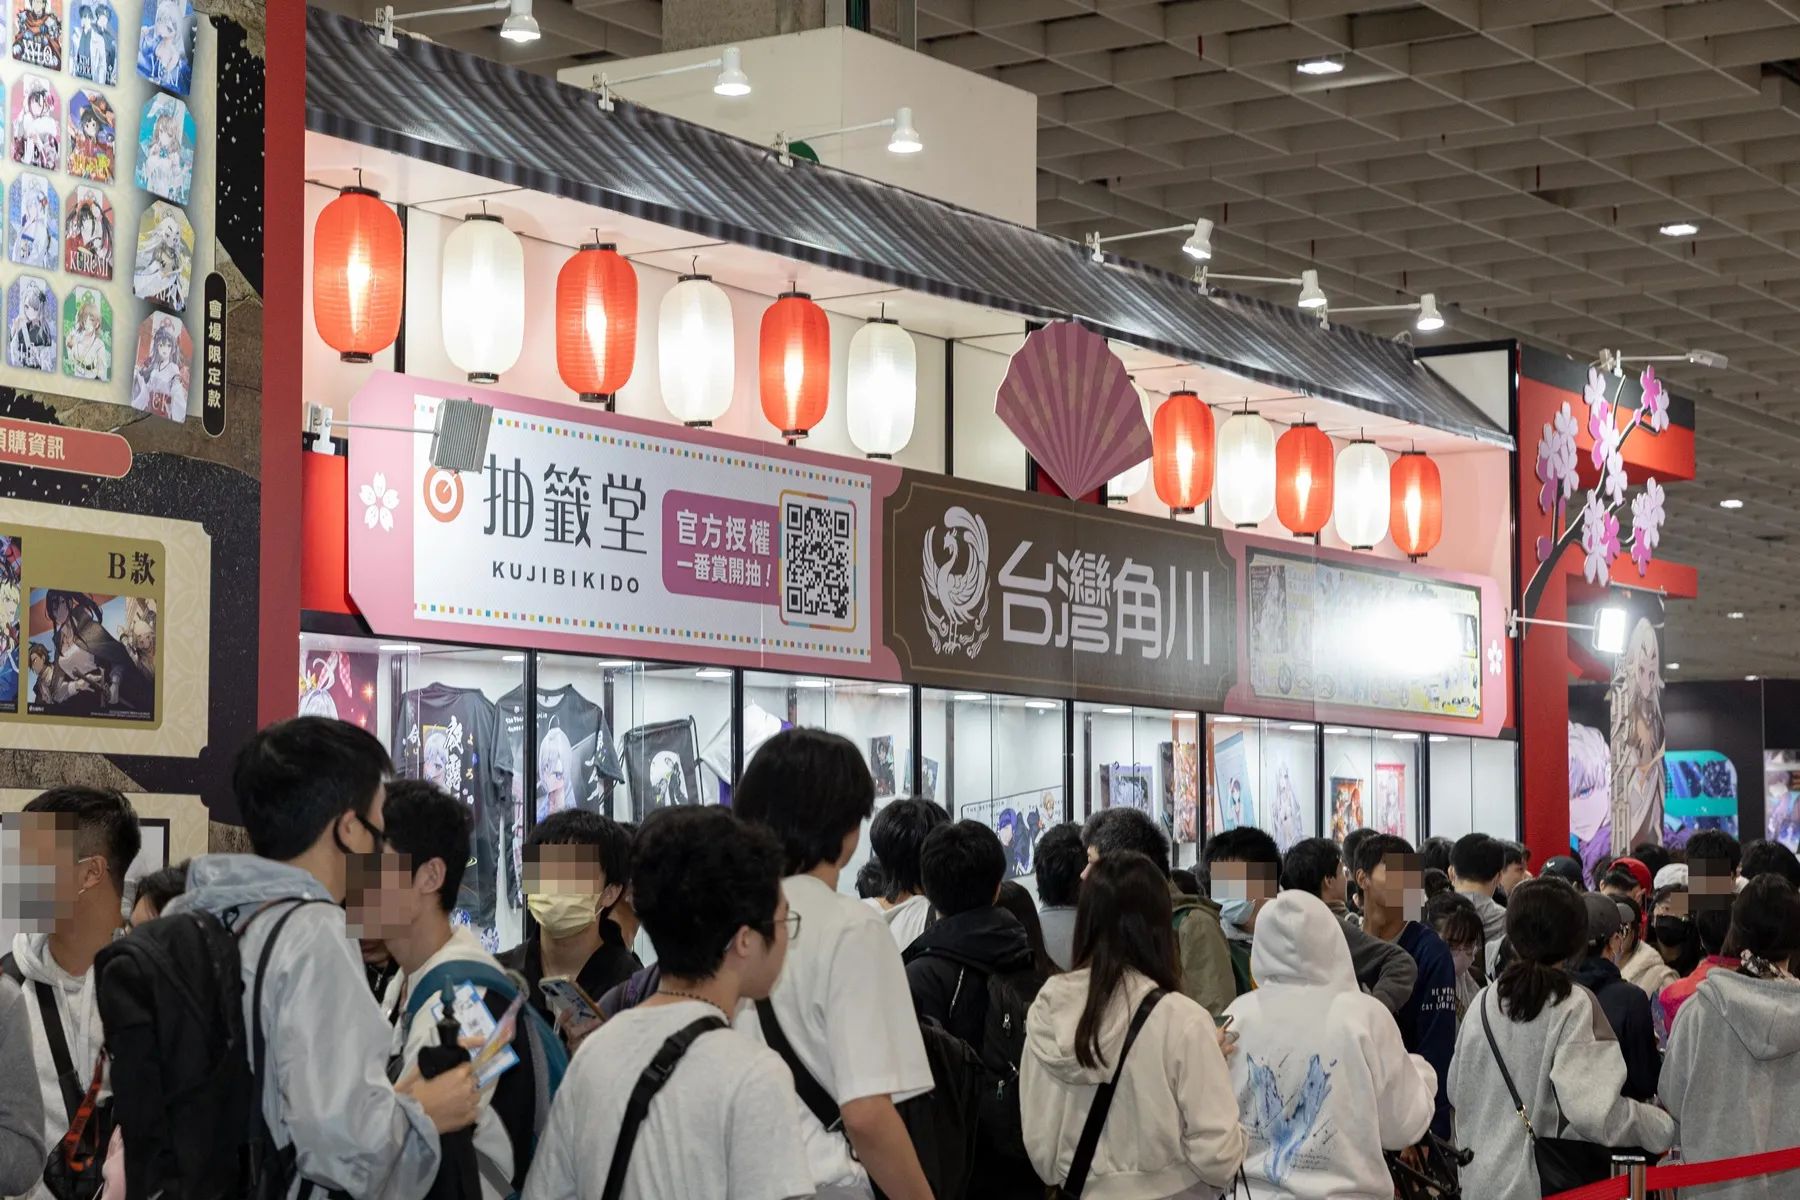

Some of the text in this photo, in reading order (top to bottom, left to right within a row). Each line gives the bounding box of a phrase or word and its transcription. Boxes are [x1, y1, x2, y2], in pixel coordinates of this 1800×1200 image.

[206, 299, 223, 409] 會場限定款
[483, 453, 648, 555] 抽籤堂
[675, 509, 772, 556] 官方授權
[492, 561, 641, 594] KUJIBIKIDO
[998, 540, 1210, 665] 台灣角川
